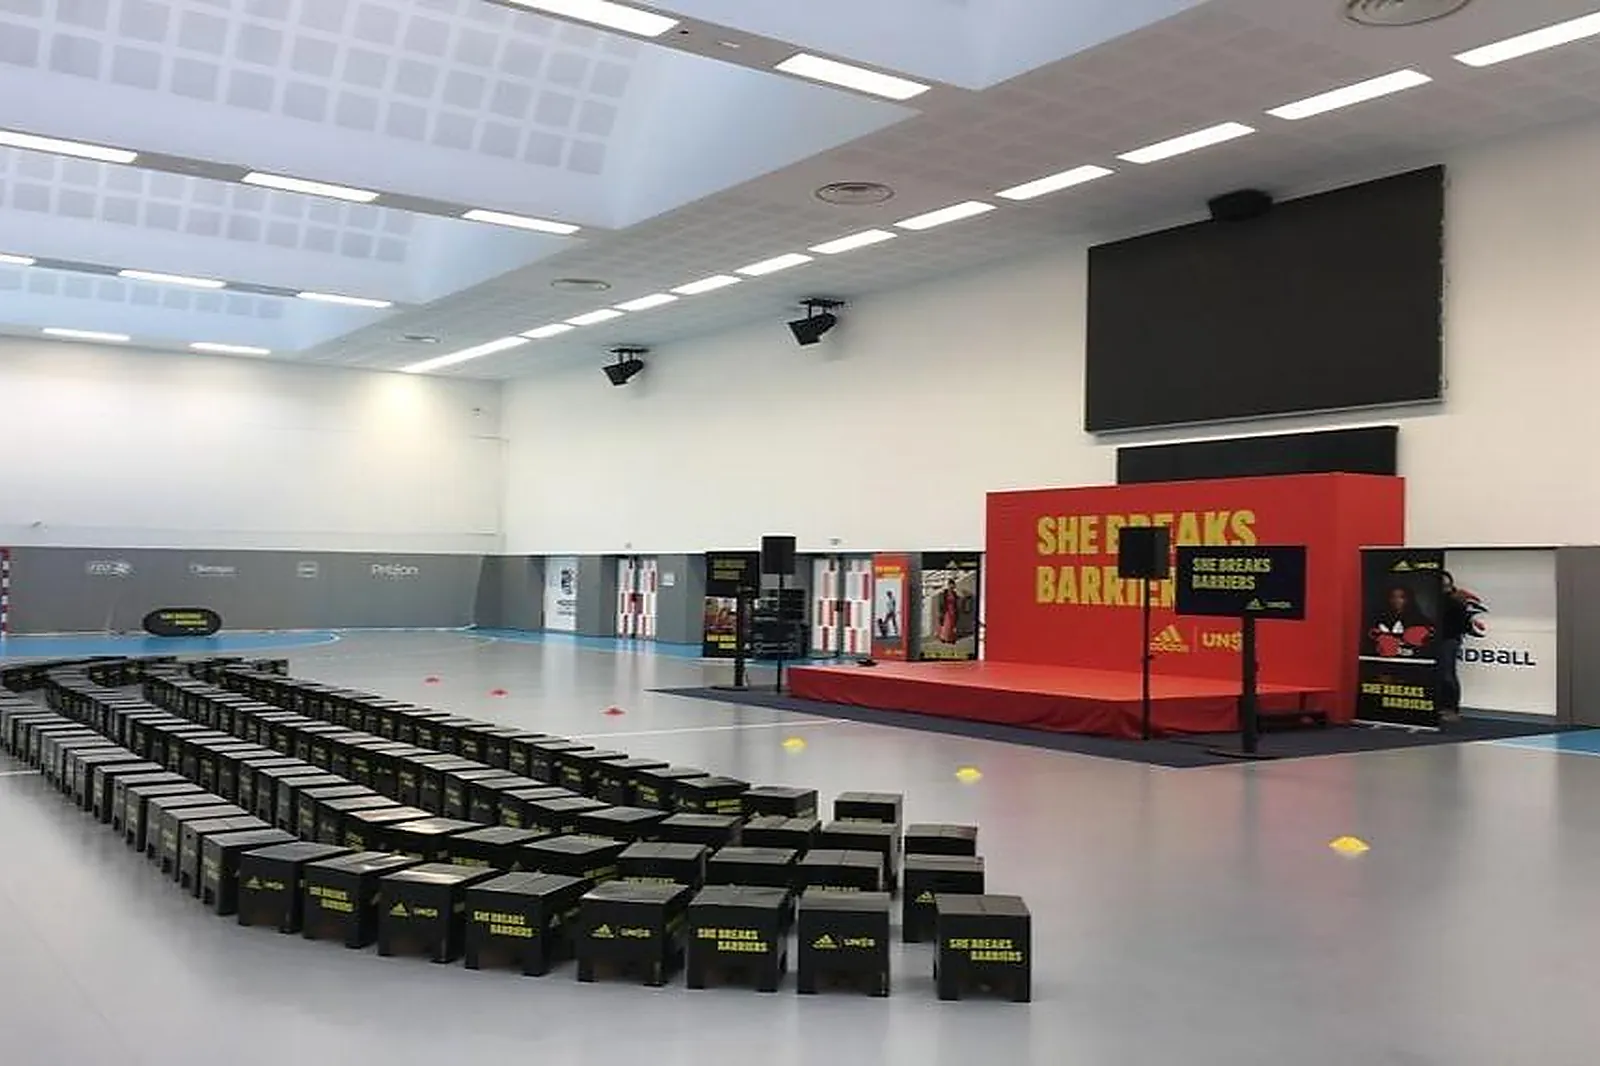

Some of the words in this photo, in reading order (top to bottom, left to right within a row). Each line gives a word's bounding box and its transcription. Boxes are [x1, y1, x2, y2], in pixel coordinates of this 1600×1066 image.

[1037, 516, 1099, 555] SHE
[1192, 558, 1216, 571] SHE
[1219, 558, 1271, 573] BREAKS
[1192, 574, 1255, 590] BARRIERS
